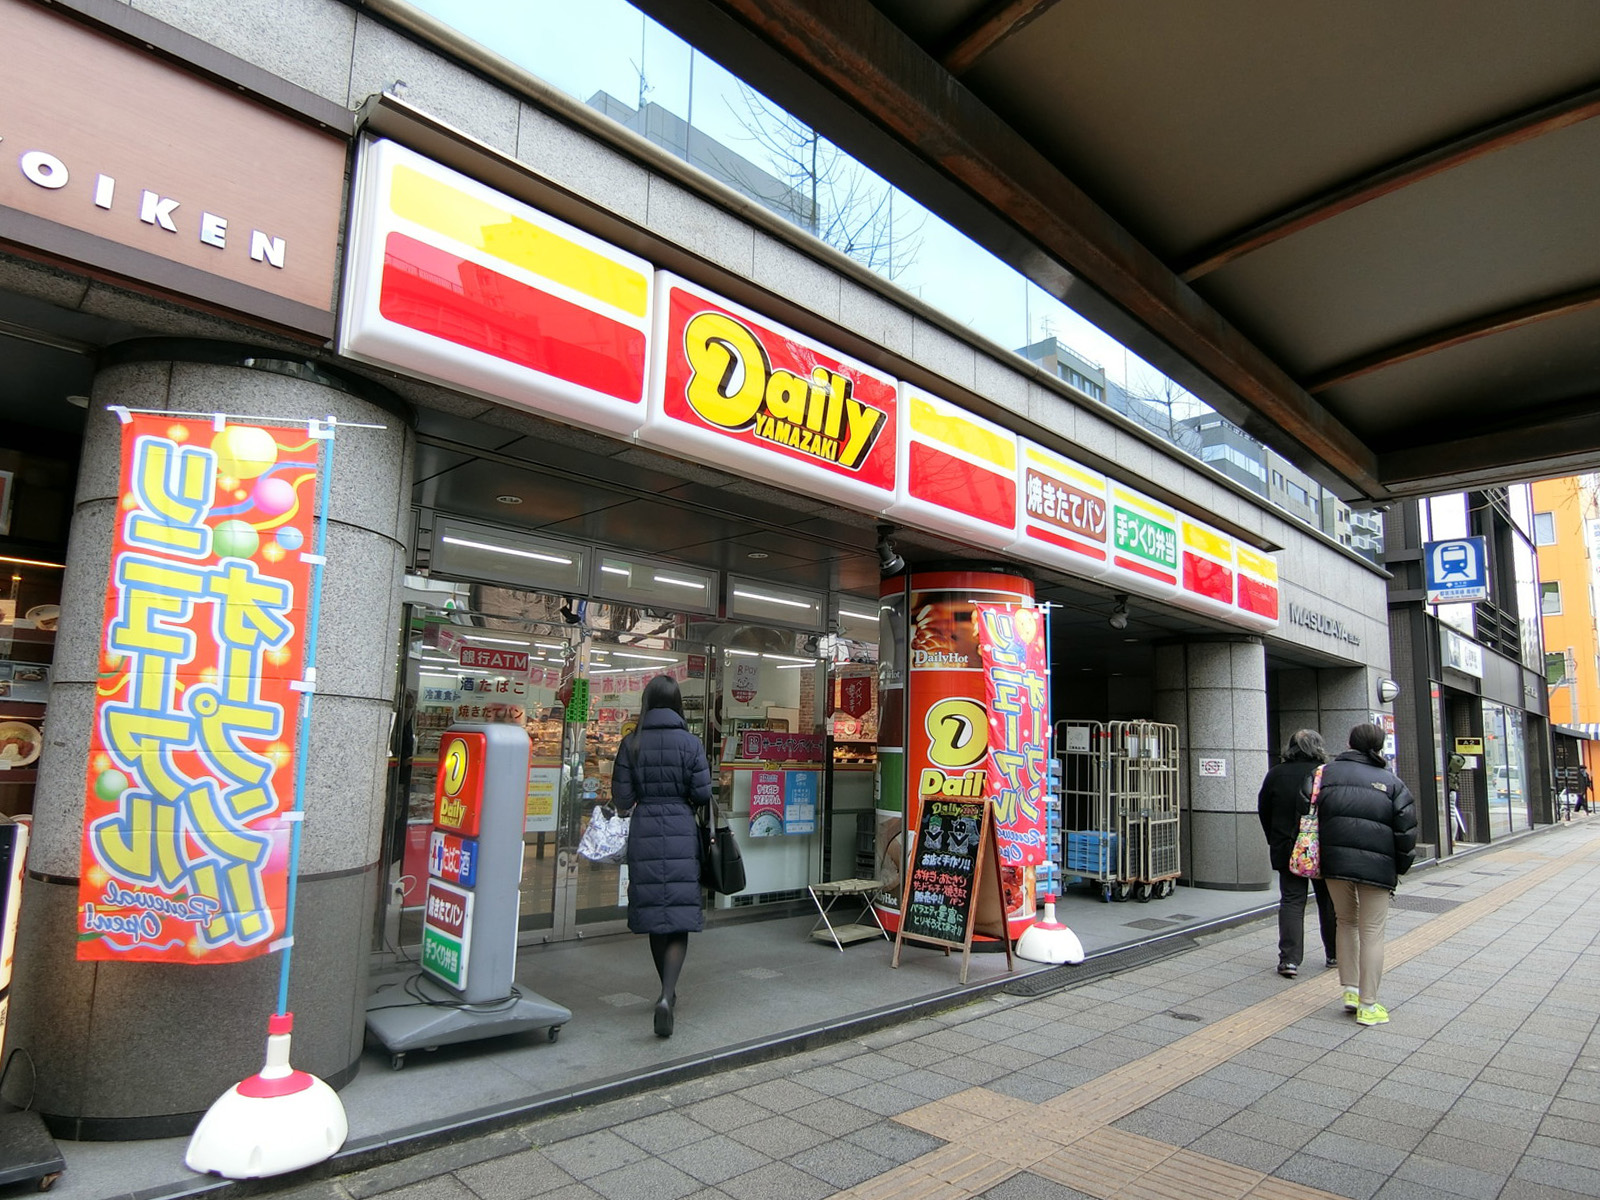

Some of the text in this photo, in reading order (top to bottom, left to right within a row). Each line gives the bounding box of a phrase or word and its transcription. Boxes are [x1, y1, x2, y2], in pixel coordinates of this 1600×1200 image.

[0, 138, 287, 269] OIKEN
[685, 312, 887, 470] Daily
[755, 411, 839, 462] YAMAZAKI
[1027, 473, 1106, 535] 焼きたてパン
[1116, 512, 1176, 565] 手づくり弁当
[462, 649, 527, 669] 銀行ATM
[460, 676, 525, 694] 酒 たばこ
[458, 705, 524, 719] 焼きたてパン
[920, 770, 988, 797] Dail
[428, 894, 464, 927] 焼きたてパン
[425, 937, 459, 974] 手づくり弁当
